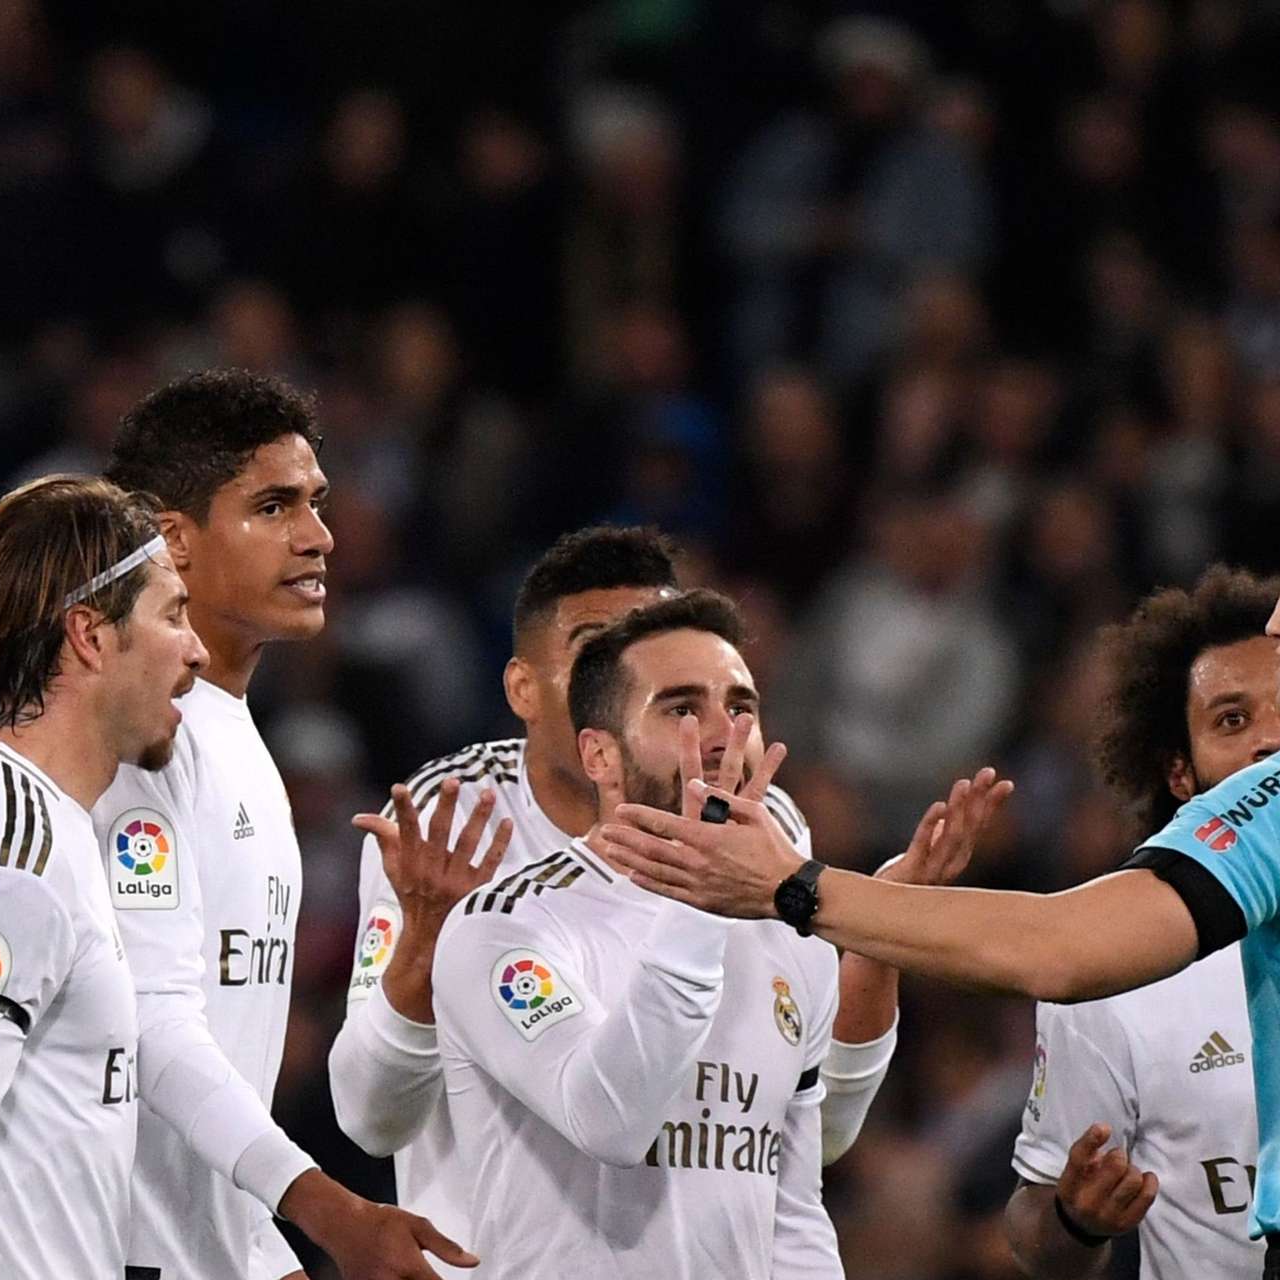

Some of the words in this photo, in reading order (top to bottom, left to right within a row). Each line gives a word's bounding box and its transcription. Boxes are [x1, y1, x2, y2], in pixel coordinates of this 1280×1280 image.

[117, 880, 172, 898] LaLiga
[268, 875, 290, 925] Fly
[521, 996, 573, 1029] LaLiga
[1189, 1052, 1245, 1074] adidas
[696, 1061, 759, 1113] Fly
